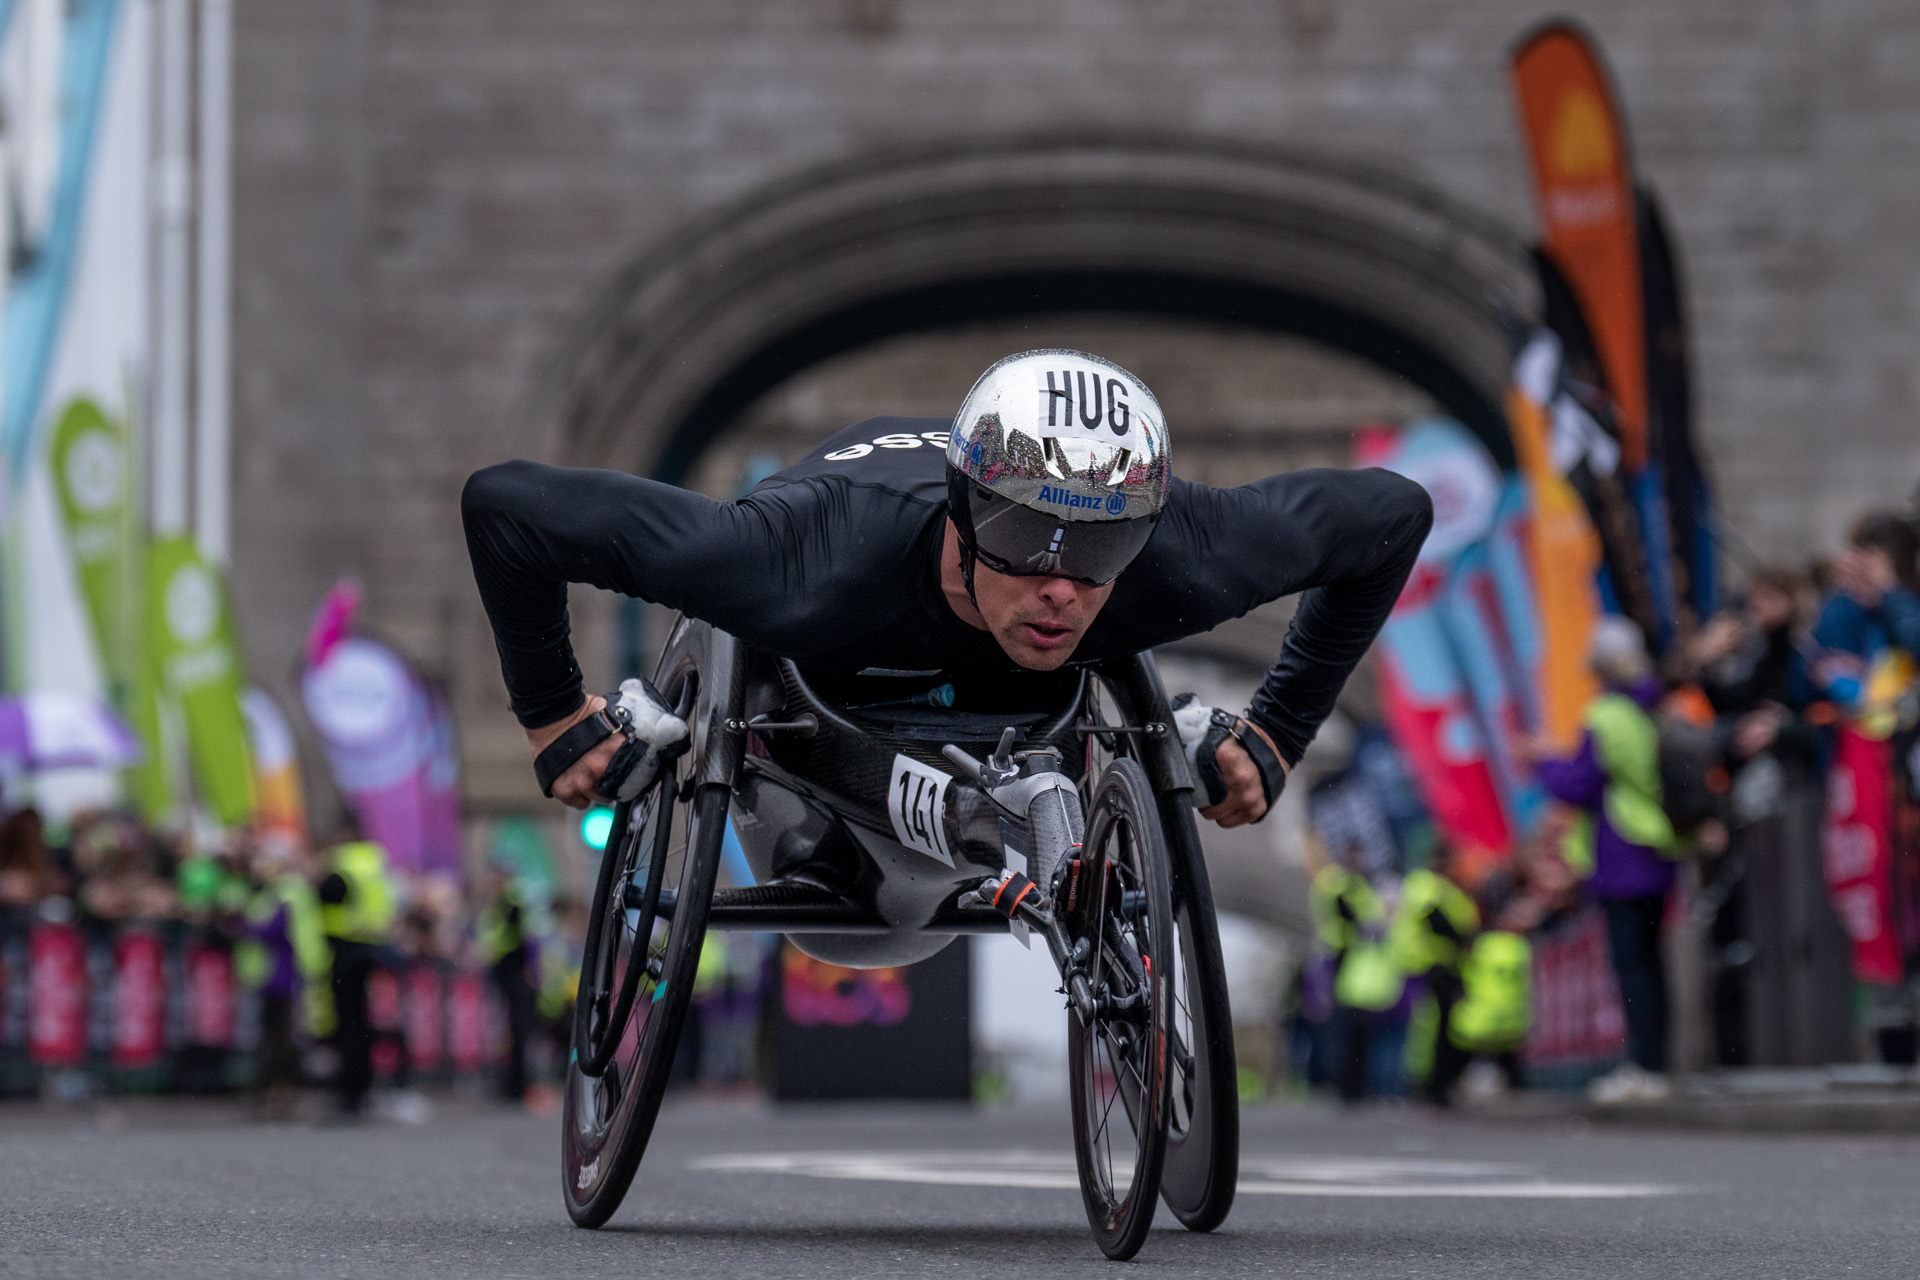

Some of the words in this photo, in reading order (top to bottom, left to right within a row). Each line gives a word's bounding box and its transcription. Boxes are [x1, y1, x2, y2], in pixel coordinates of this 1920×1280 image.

[1046, 369, 1129, 436] HUG
[1038, 485, 1102, 510] Allianz
[899, 769, 944, 855] 141
